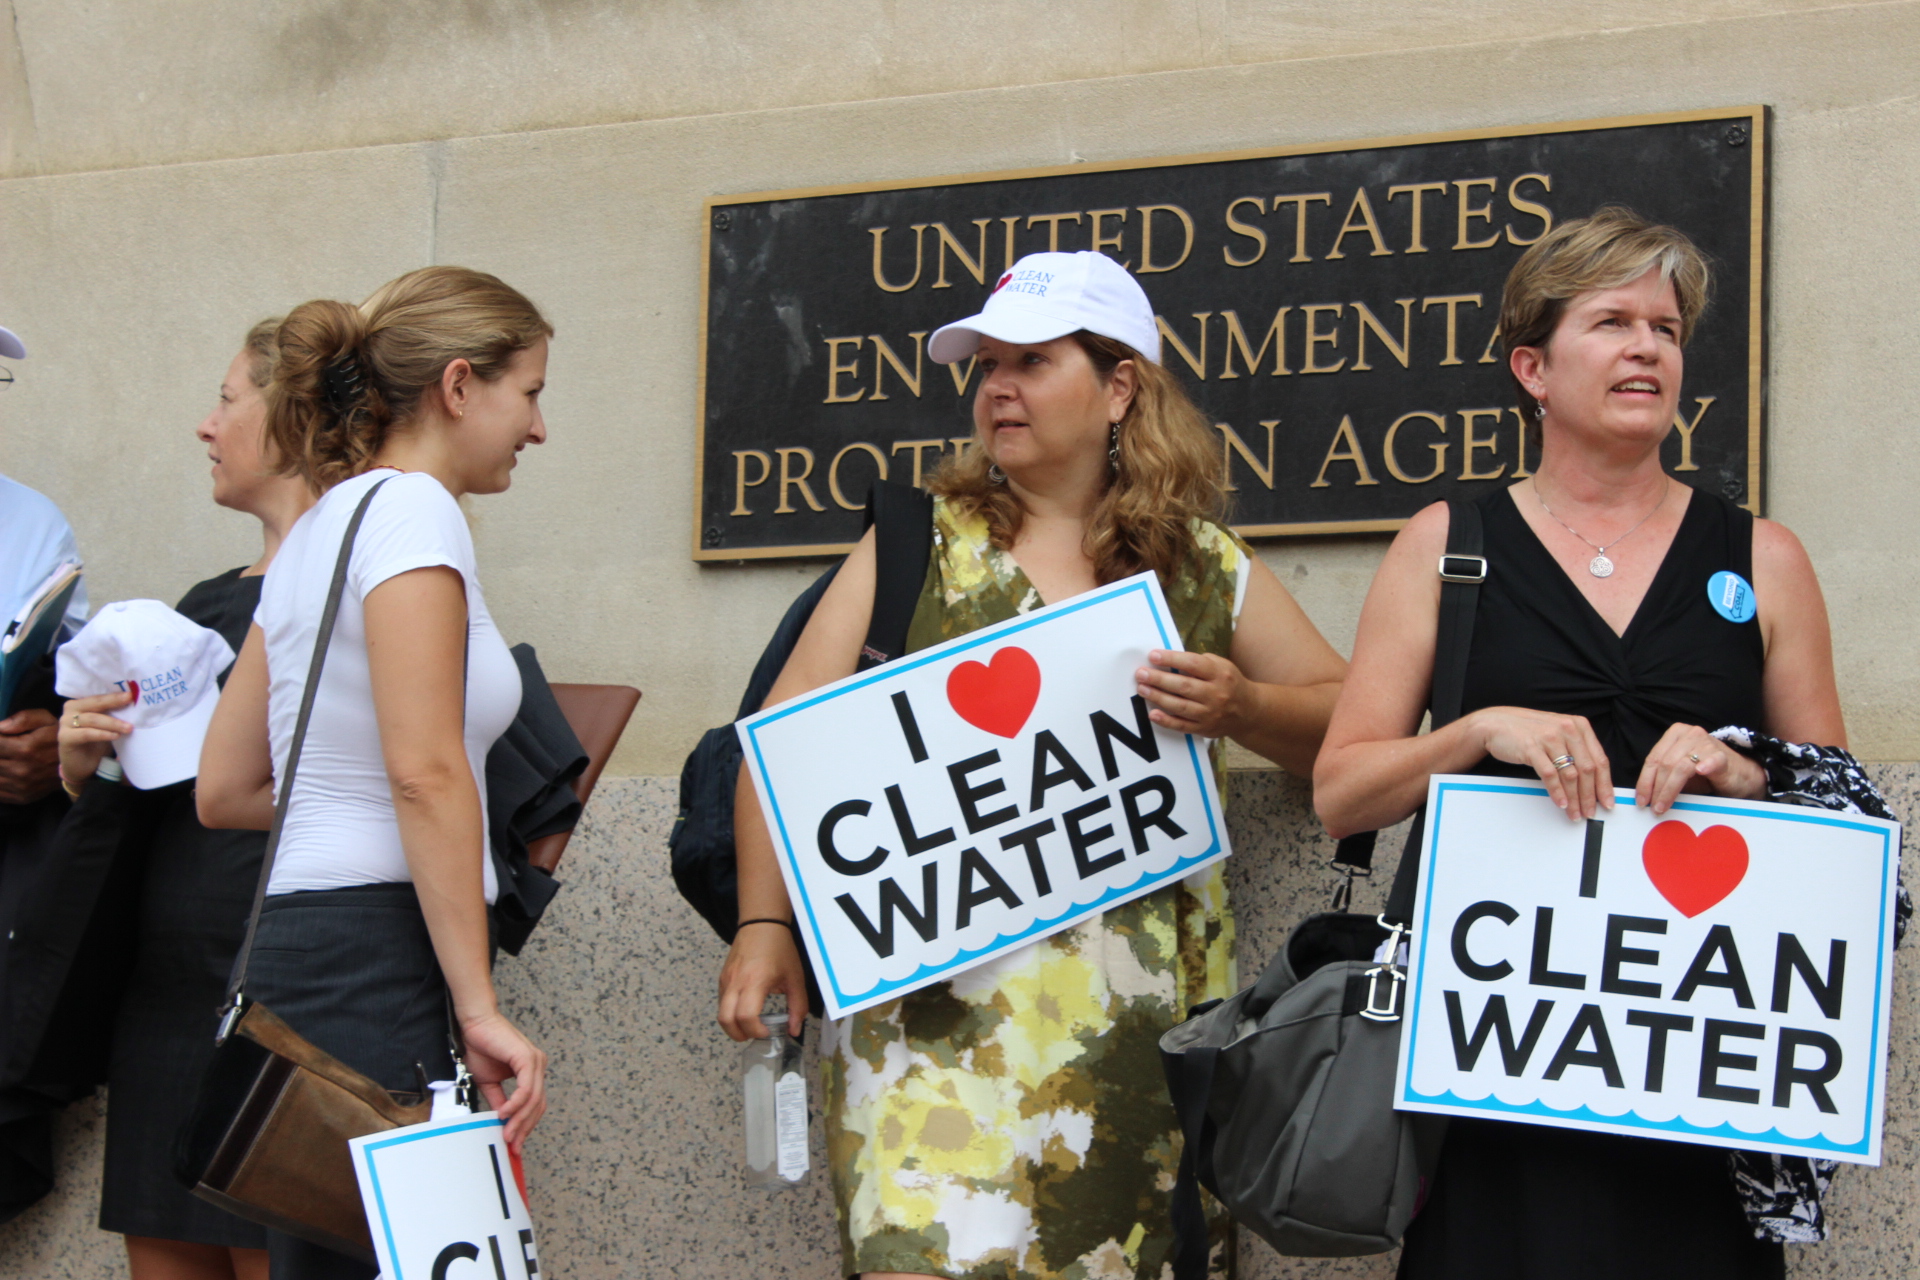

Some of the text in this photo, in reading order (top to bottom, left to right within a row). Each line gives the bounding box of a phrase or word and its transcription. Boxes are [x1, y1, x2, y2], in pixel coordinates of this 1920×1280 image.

[868, 173, 1553, 293] UNITED STATES
[1005, 283, 1047, 297] WATER
[1013, 270, 1055, 283] CLEAN
[141, 666, 182, 692] CLEAN
[143, 680, 188, 706] WATER
[890, 690, 929, 764] I
[817, 694, 1161, 877] CLEAN
[834, 775, 1188, 960] WATER
[1578, 817, 1605, 899] I
[1450, 900, 1847, 1020] CLEAN
[1443, 990, 1843, 1115] WATER
[488, 1144, 511, 1220] I
